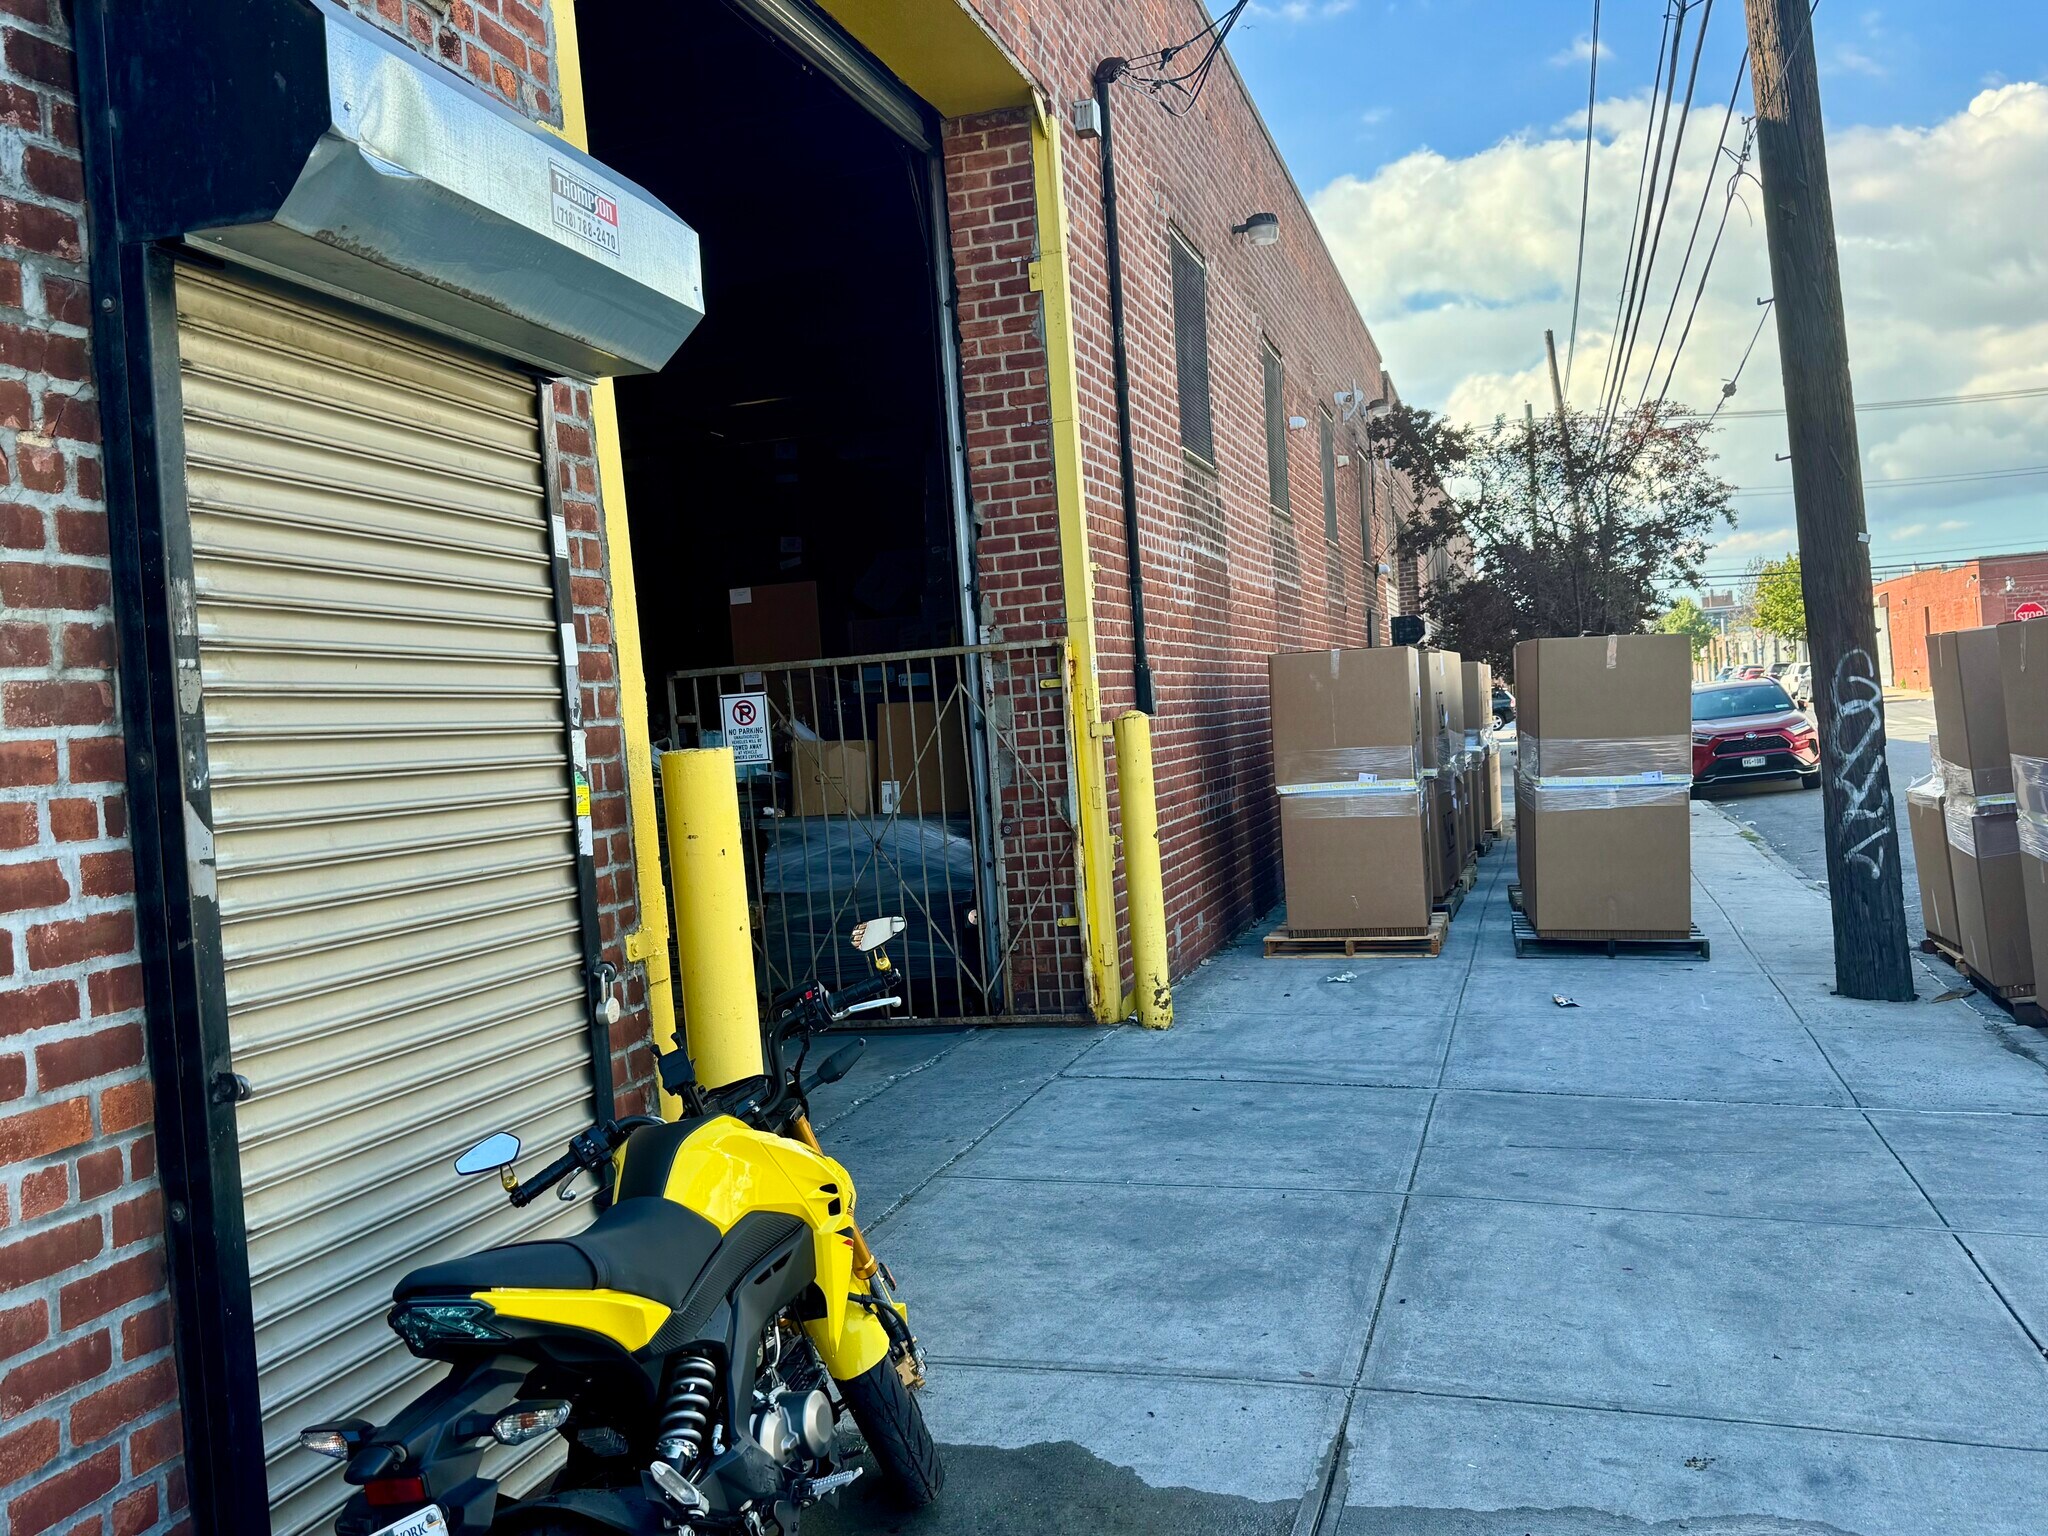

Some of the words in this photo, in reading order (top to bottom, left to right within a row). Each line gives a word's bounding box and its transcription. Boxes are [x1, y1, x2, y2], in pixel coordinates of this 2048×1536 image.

[555, 174, 613, 222] THOMPSON
[557, 206, 575, 228] (718)
[578, 217, 615, 249] 788-2470
[2017, 611, 2043, 620] STOP
[739, 727, 763, 735] PARKING
